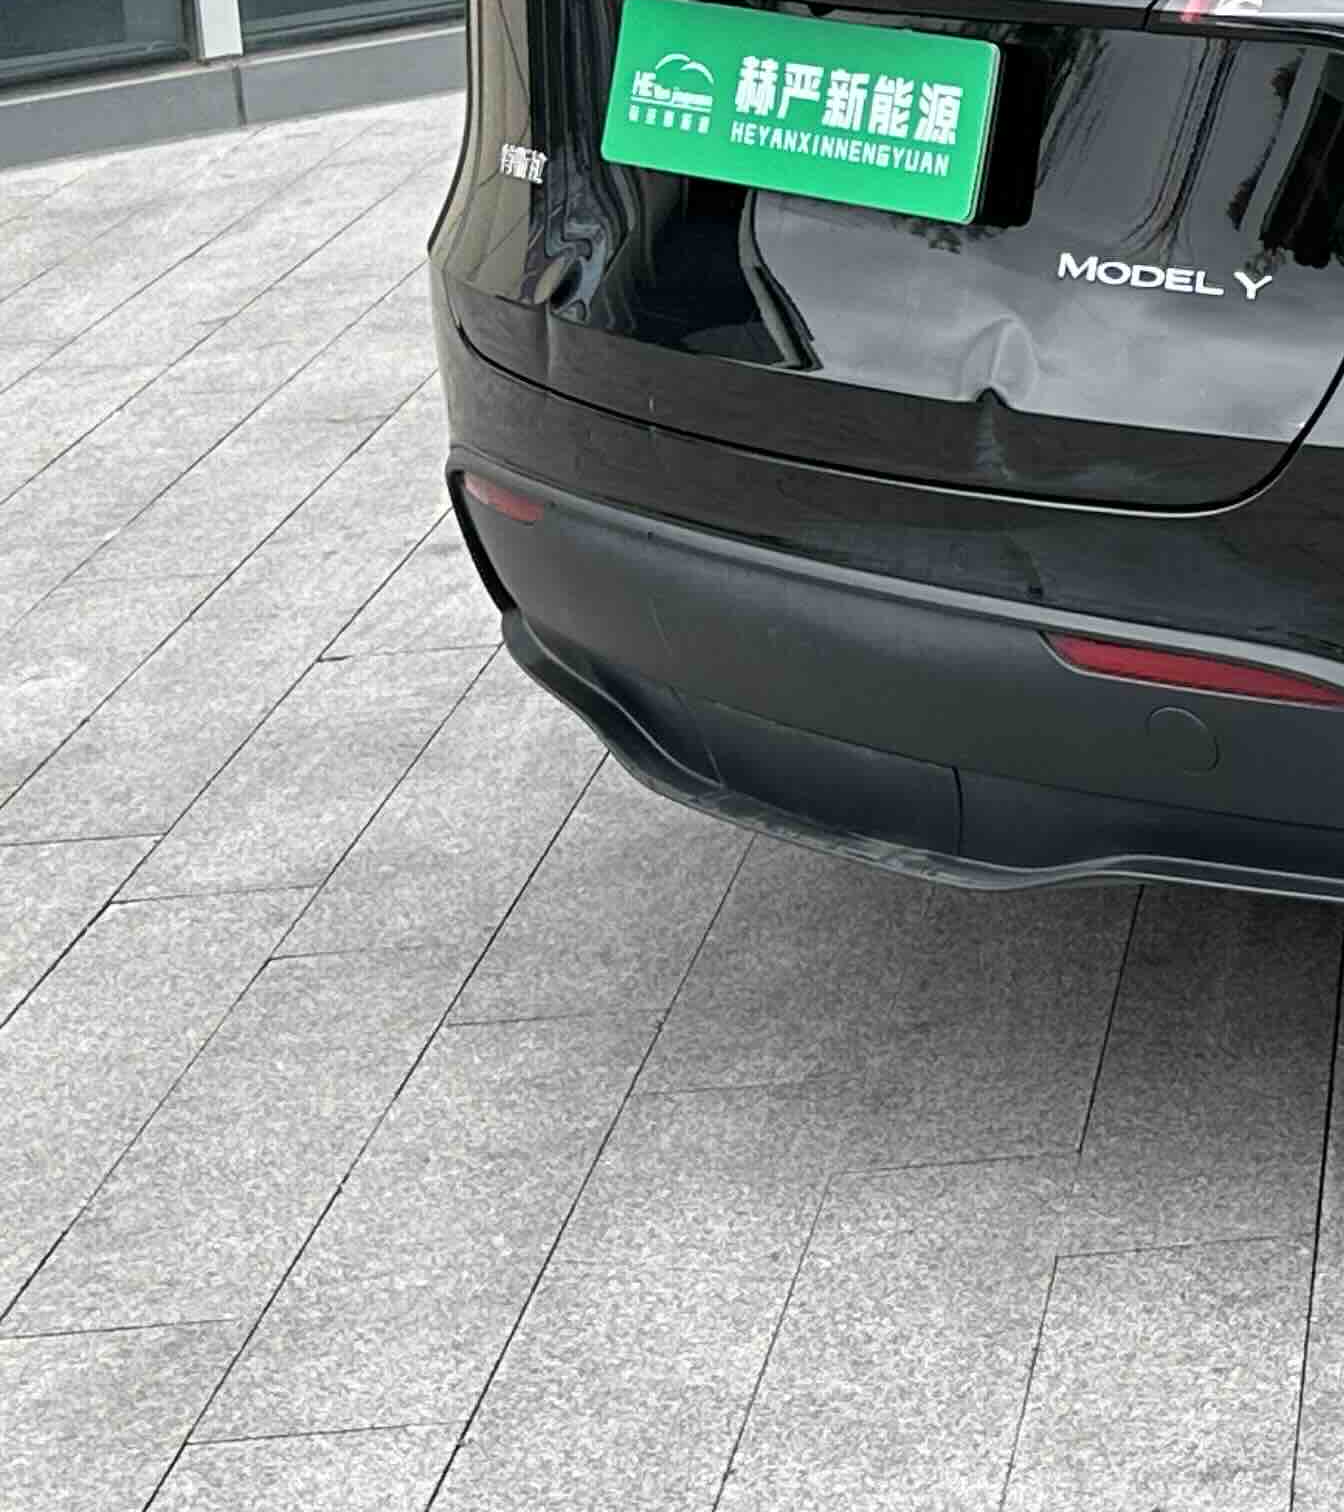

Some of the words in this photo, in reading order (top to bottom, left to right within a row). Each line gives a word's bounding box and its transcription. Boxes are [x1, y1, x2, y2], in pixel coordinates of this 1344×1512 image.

[734, 54, 964, 146] 赫严新能源
[730, 119, 950, 177] HEYANXINNENGYUAN
[1057, 252, 1225, 297] MODEL
[1233, 270, 1274, 301] Y
